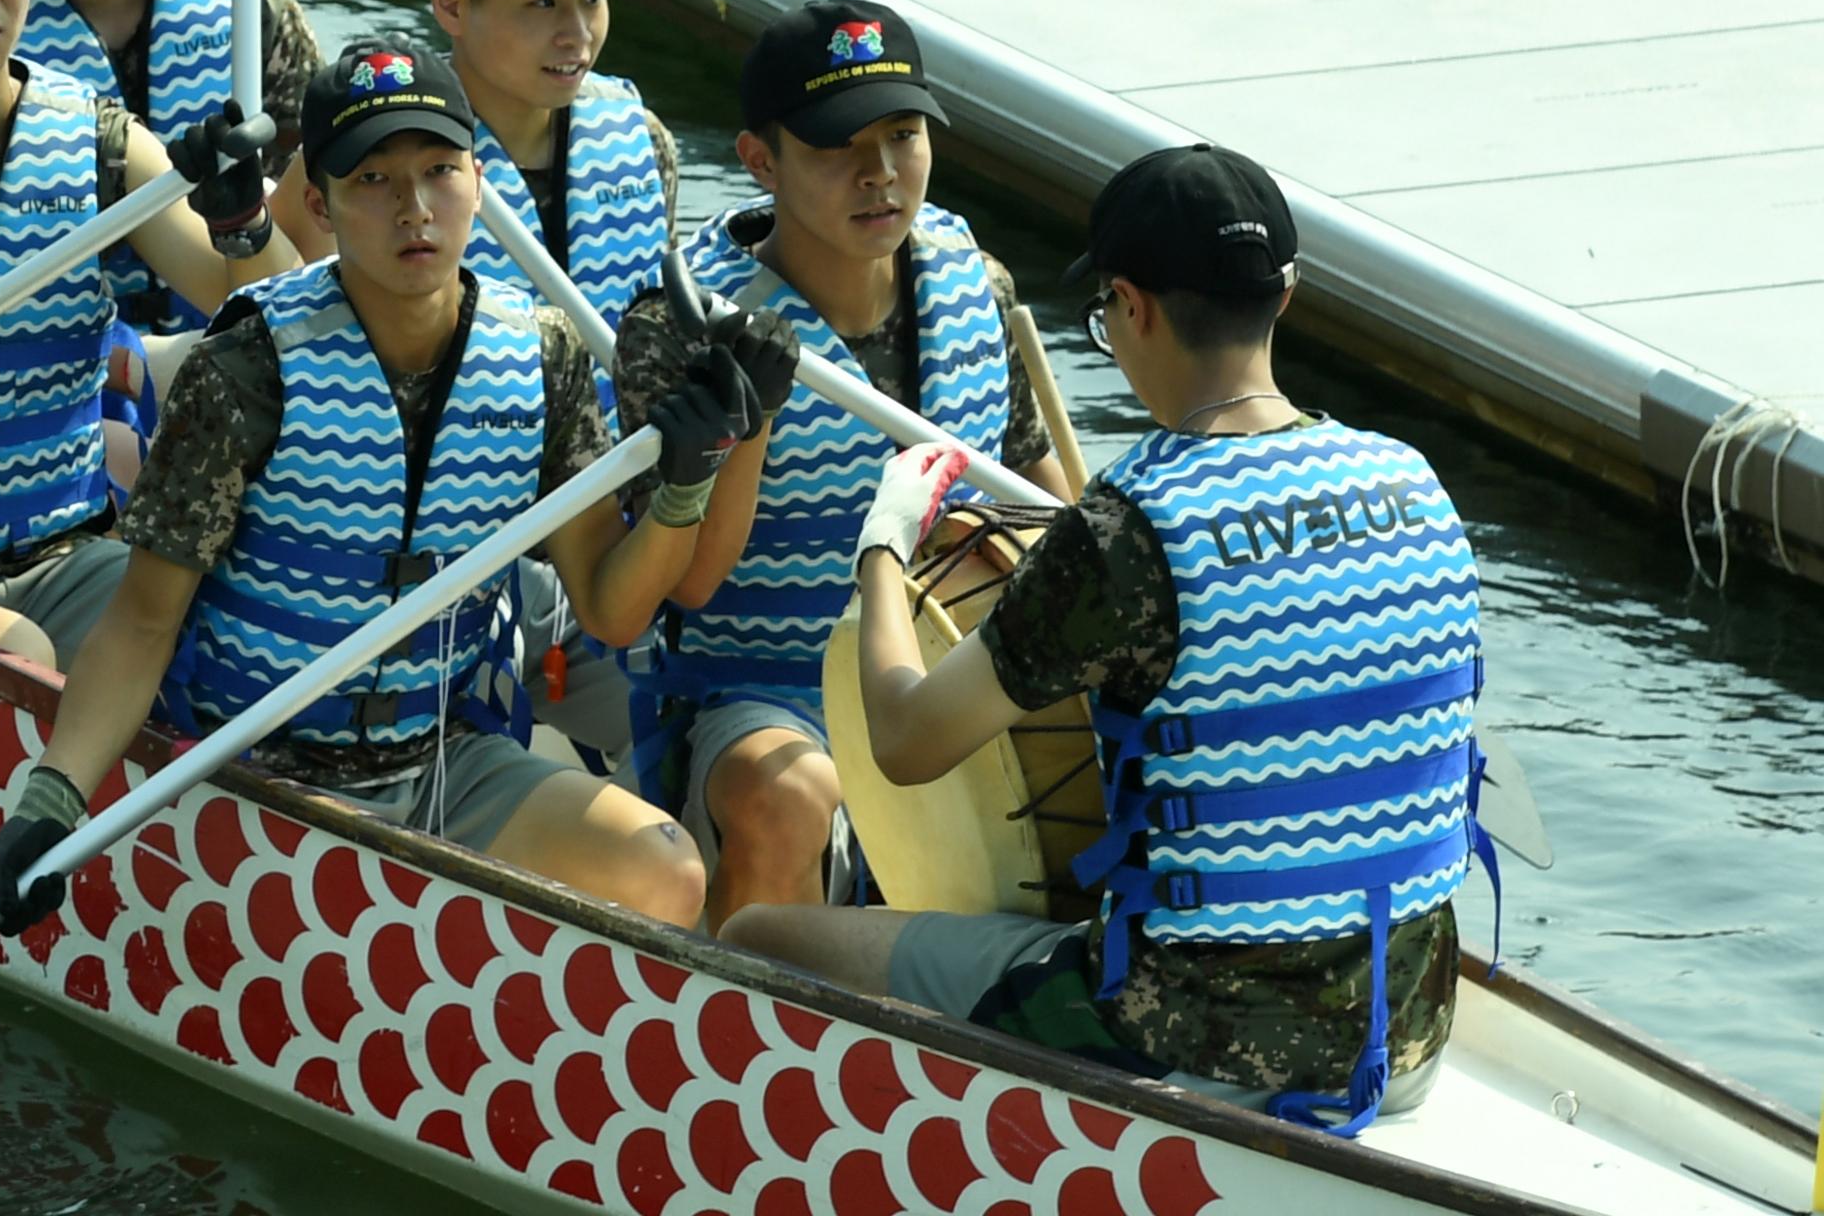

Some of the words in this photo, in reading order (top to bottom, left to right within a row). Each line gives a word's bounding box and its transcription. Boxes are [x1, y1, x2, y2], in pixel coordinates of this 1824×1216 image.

[805, 68, 850, 91] REPUBLIC
[851, 66, 864, 76] OF
[332, 99, 369, 127] REPUBLIC
[372, 96, 386, 106] OF
[388, 94, 421, 103] KOREA
